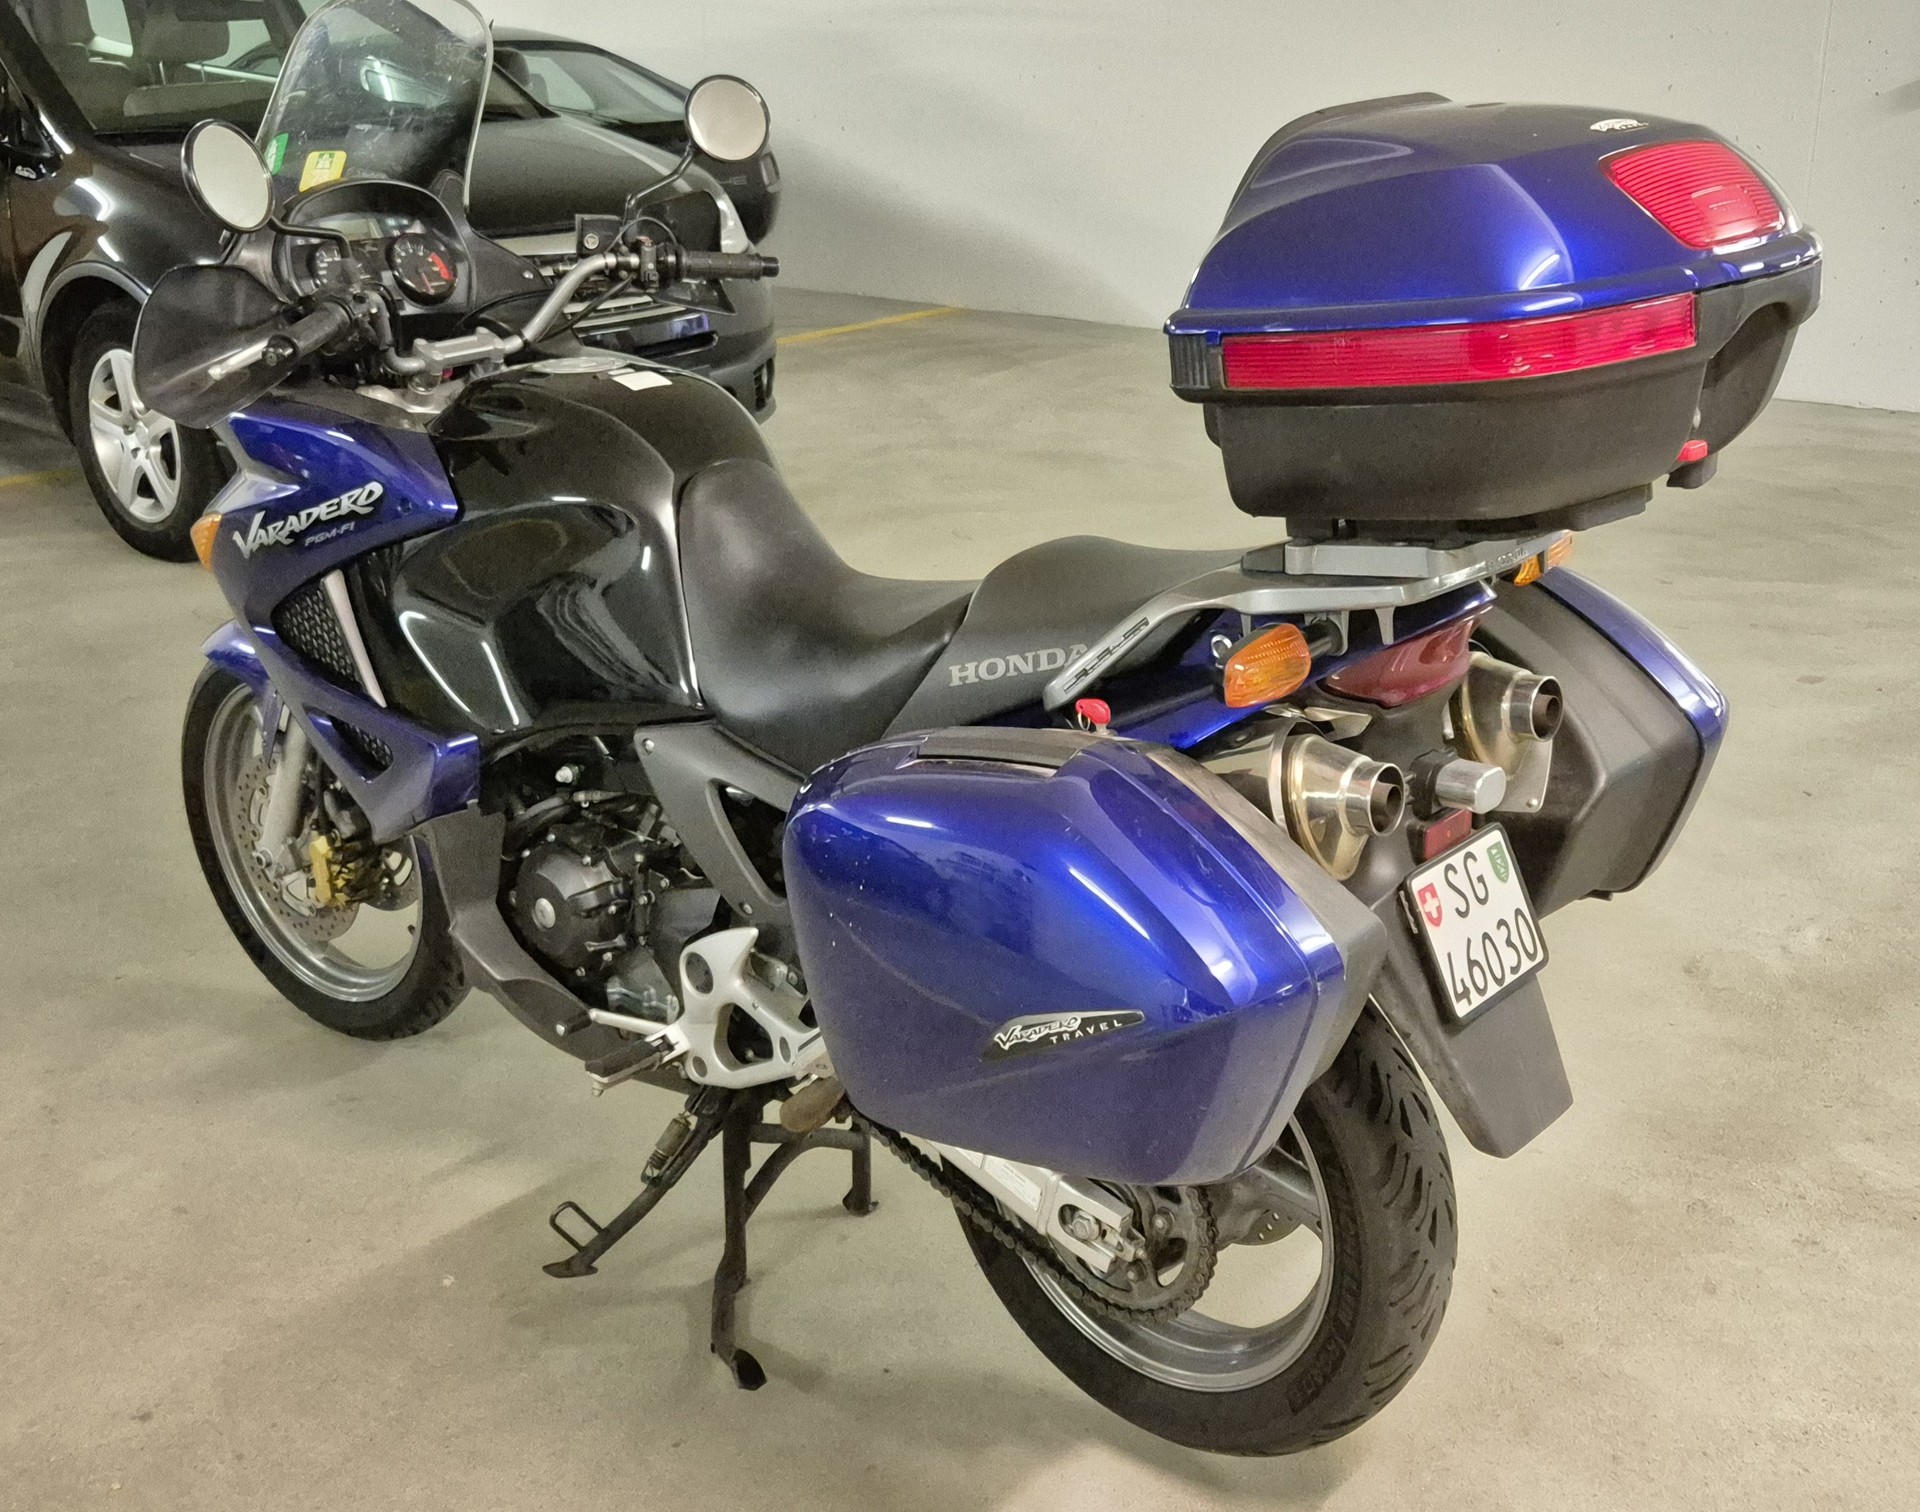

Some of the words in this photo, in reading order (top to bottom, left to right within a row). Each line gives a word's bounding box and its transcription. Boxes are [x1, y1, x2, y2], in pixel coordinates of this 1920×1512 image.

[232, 481, 384, 560] VARADERO
[304, 521, 356, 547] PGM-FI
[1443, 851, 1490, 919] SG
[1447, 907, 1538, 1007] 46030
[1049, 1019, 1123, 1045] TRAVEL
